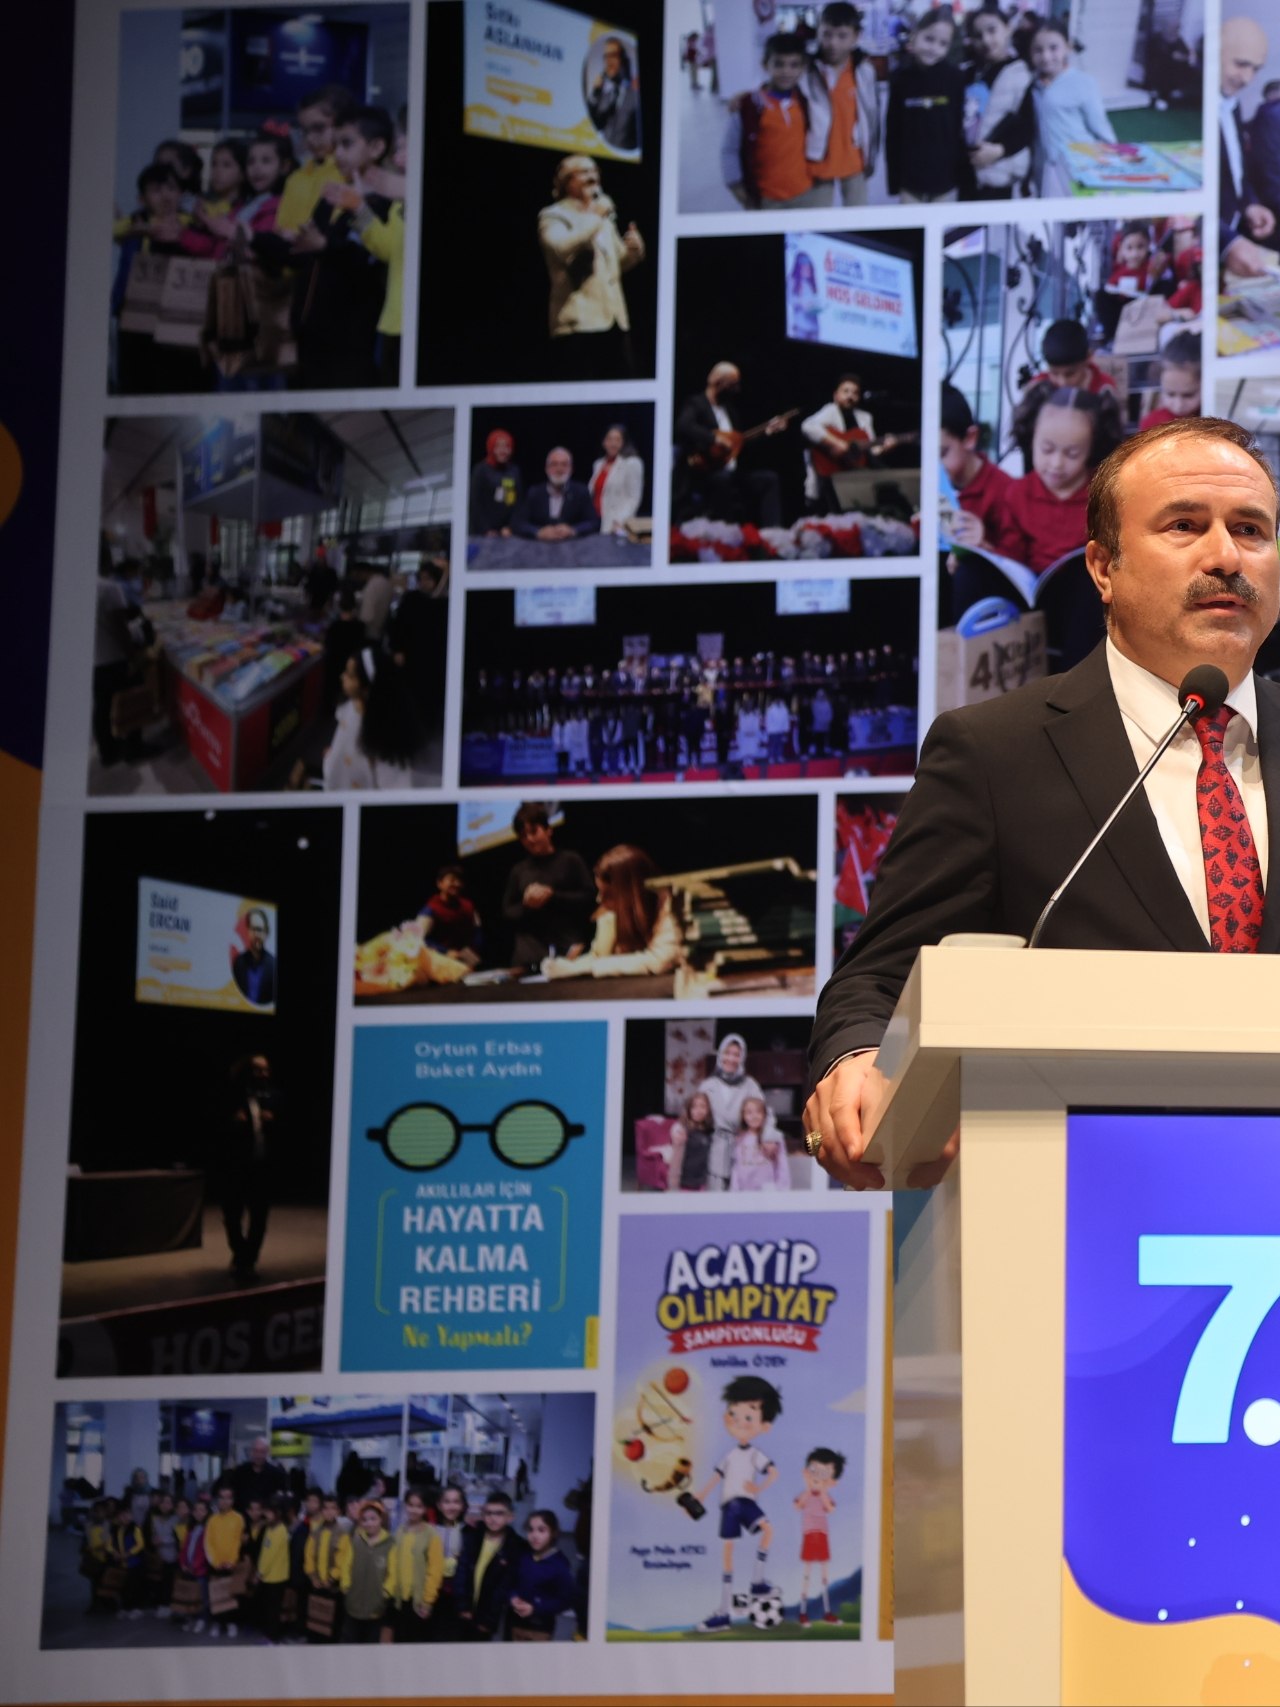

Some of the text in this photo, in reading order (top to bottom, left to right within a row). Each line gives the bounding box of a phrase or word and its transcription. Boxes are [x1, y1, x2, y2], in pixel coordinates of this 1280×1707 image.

[415, 1040, 543, 1058] Oytun Erbaş
[415, 1062, 542, 1079] Buket Aydın
[402, 1204, 545, 1234] HAYATTA
[415, 1244, 529, 1274] KALMA
[667, 1238, 818, 1294] ACAYİP
[400, 1278, 541, 1315] REHBERİ
[657, 1283, 837, 1331] OLİMPİYAT
[403, 1324, 430, 1348] Ne
